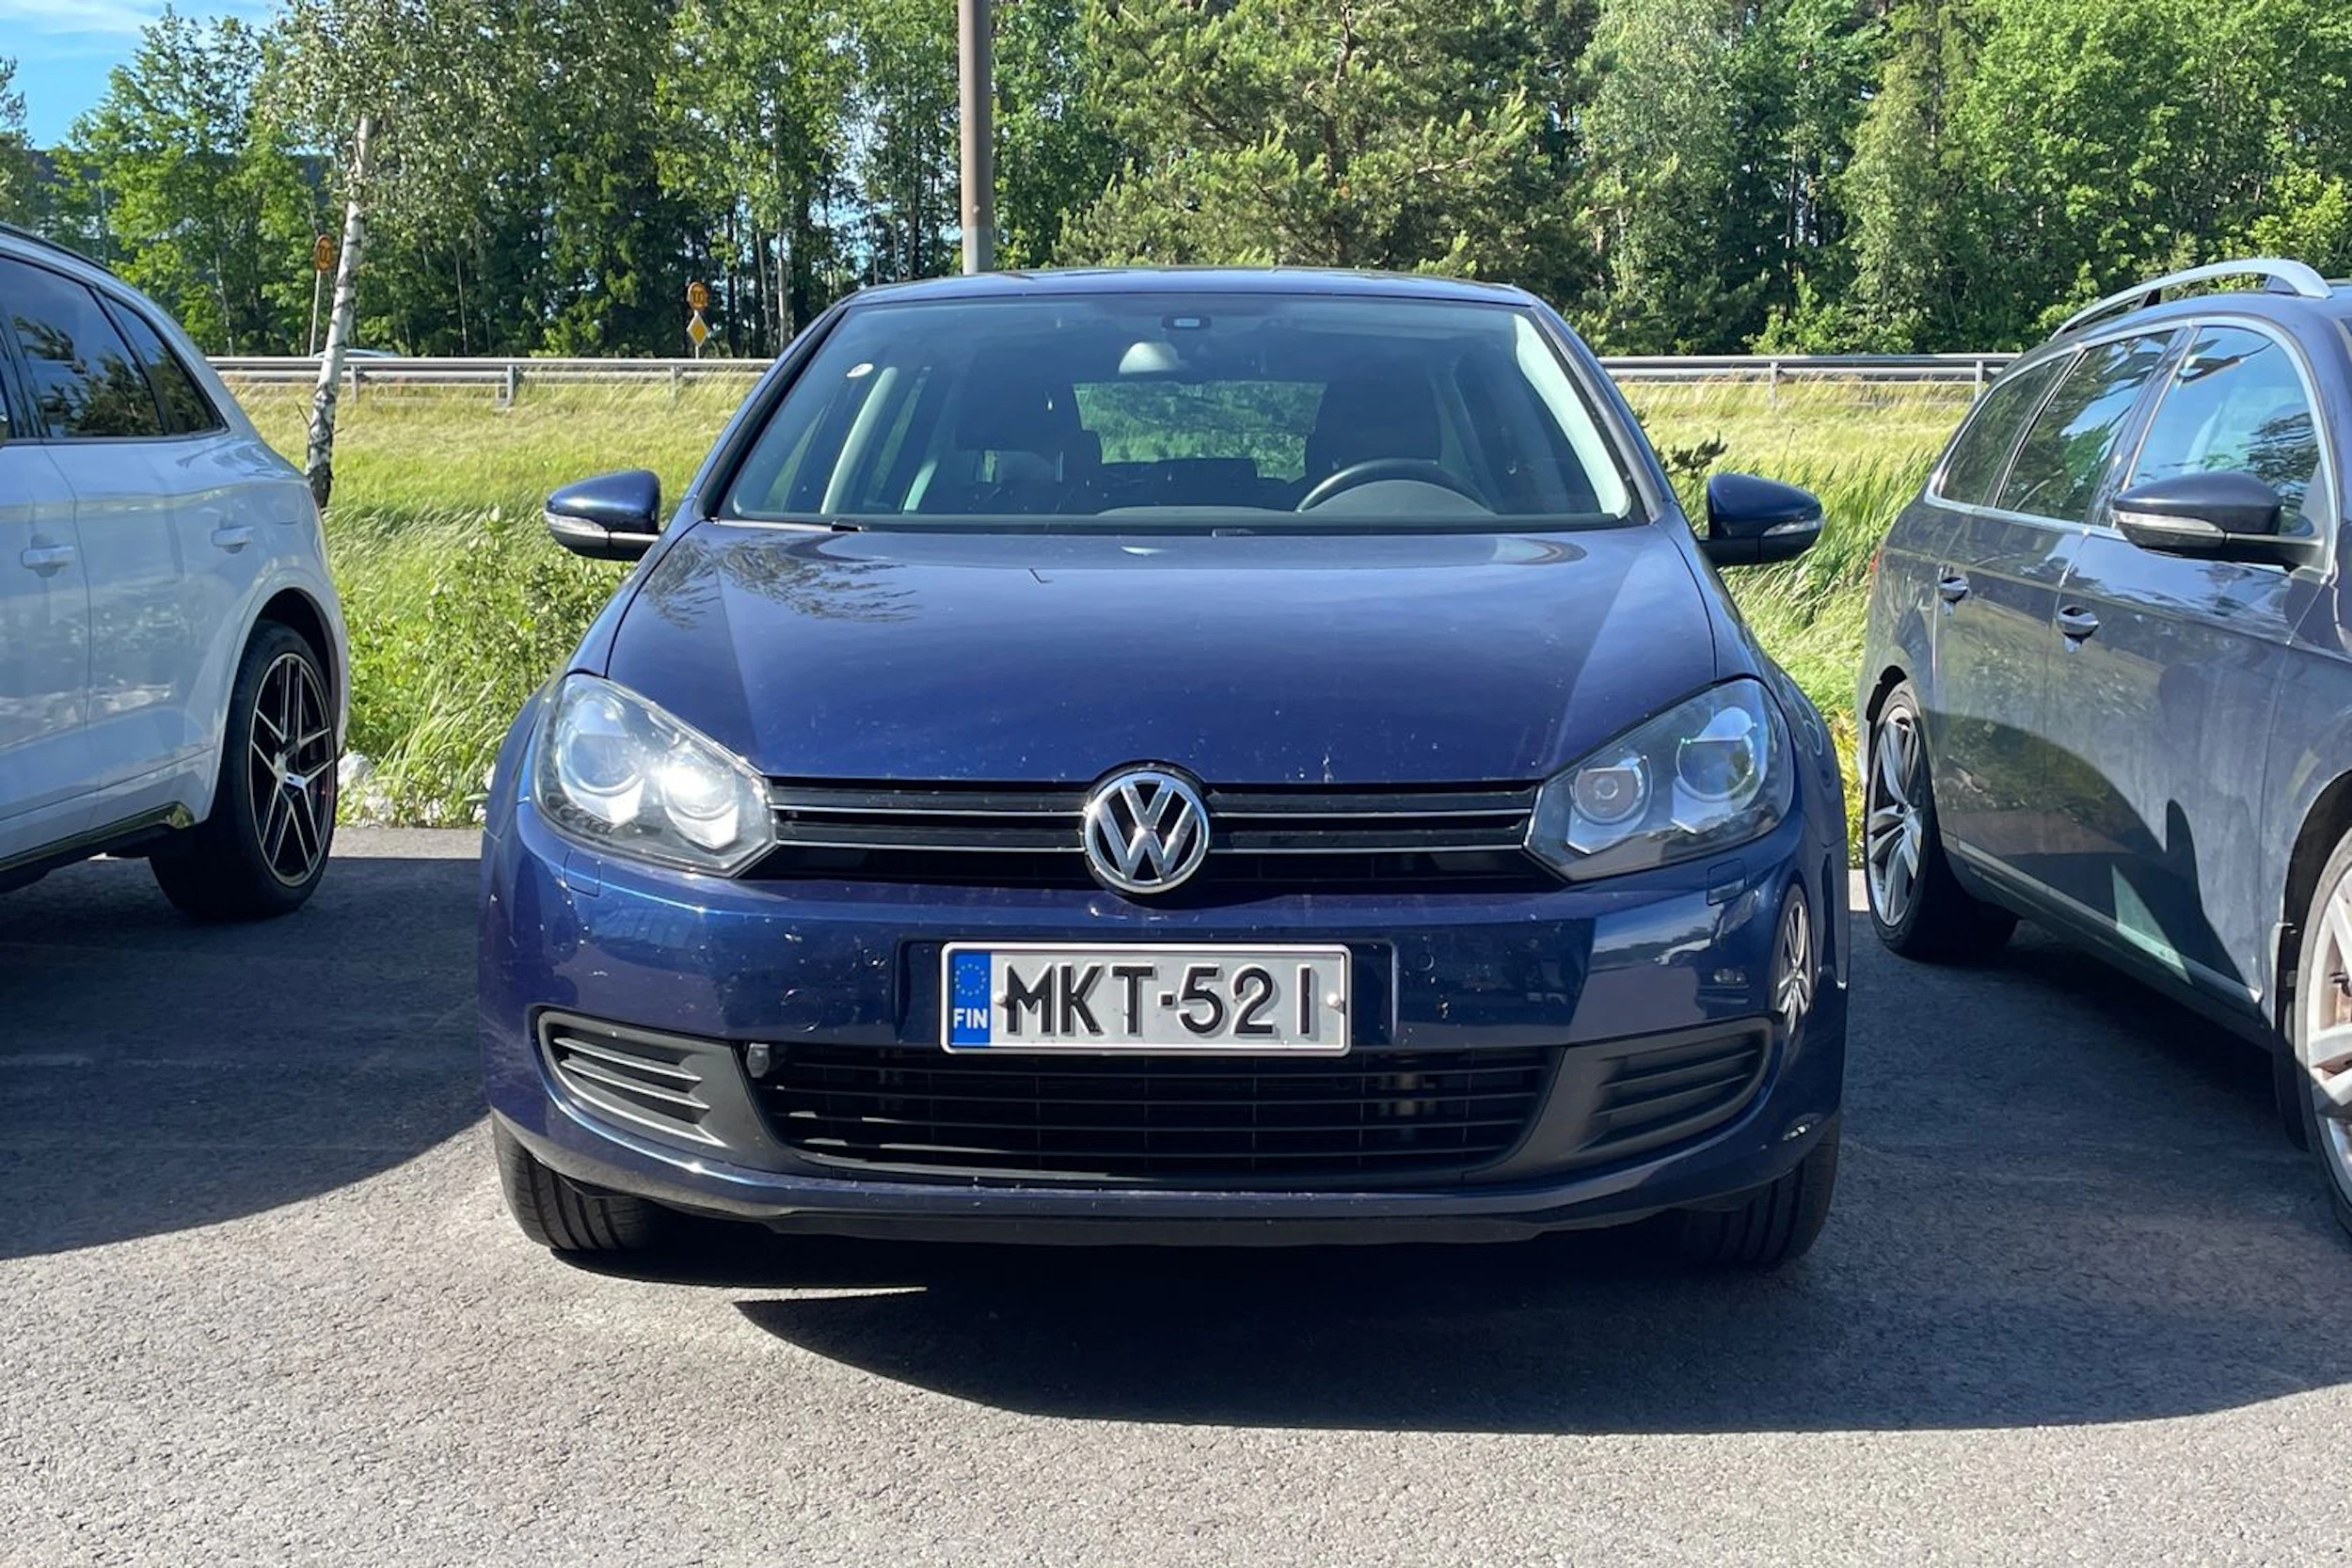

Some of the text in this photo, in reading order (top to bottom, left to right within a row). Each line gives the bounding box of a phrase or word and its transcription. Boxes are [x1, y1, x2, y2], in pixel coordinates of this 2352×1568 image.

[1093, 777, 1200, 887] VW
[953, 1007, 988, 1029] FIN
[1006, 964, 1313, 1035] MKT-521
